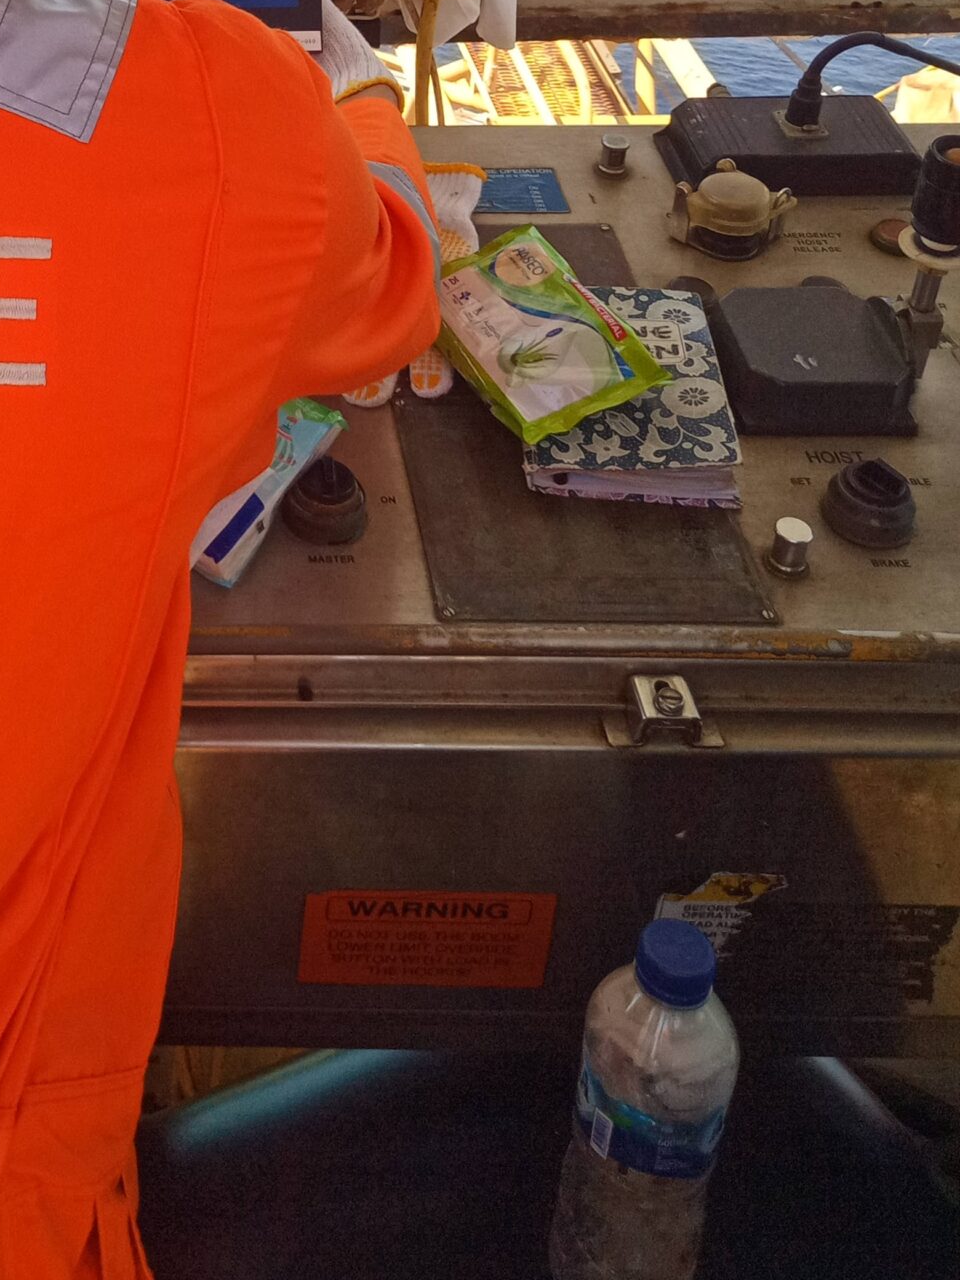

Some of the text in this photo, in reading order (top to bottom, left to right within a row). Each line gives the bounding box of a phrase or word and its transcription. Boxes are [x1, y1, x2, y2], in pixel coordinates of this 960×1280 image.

[782, 231, 842, 239] MERGENCY
[792, 245, 843, 253] RELEASE
[804, 449, 865, 465] HOIST
[789, 477, 812, 486] SET
[907, 477, 933, 487] BLE
[380, 495, 397, 505] ON
[307, 554, 356, 564] MASTER
[869, 558, 912, 569] BRAKE
[347, 899, 510, 920] WARNING
[683, 903, 731, 912] BEFORE
[688, 920, 713, 928] EAD
